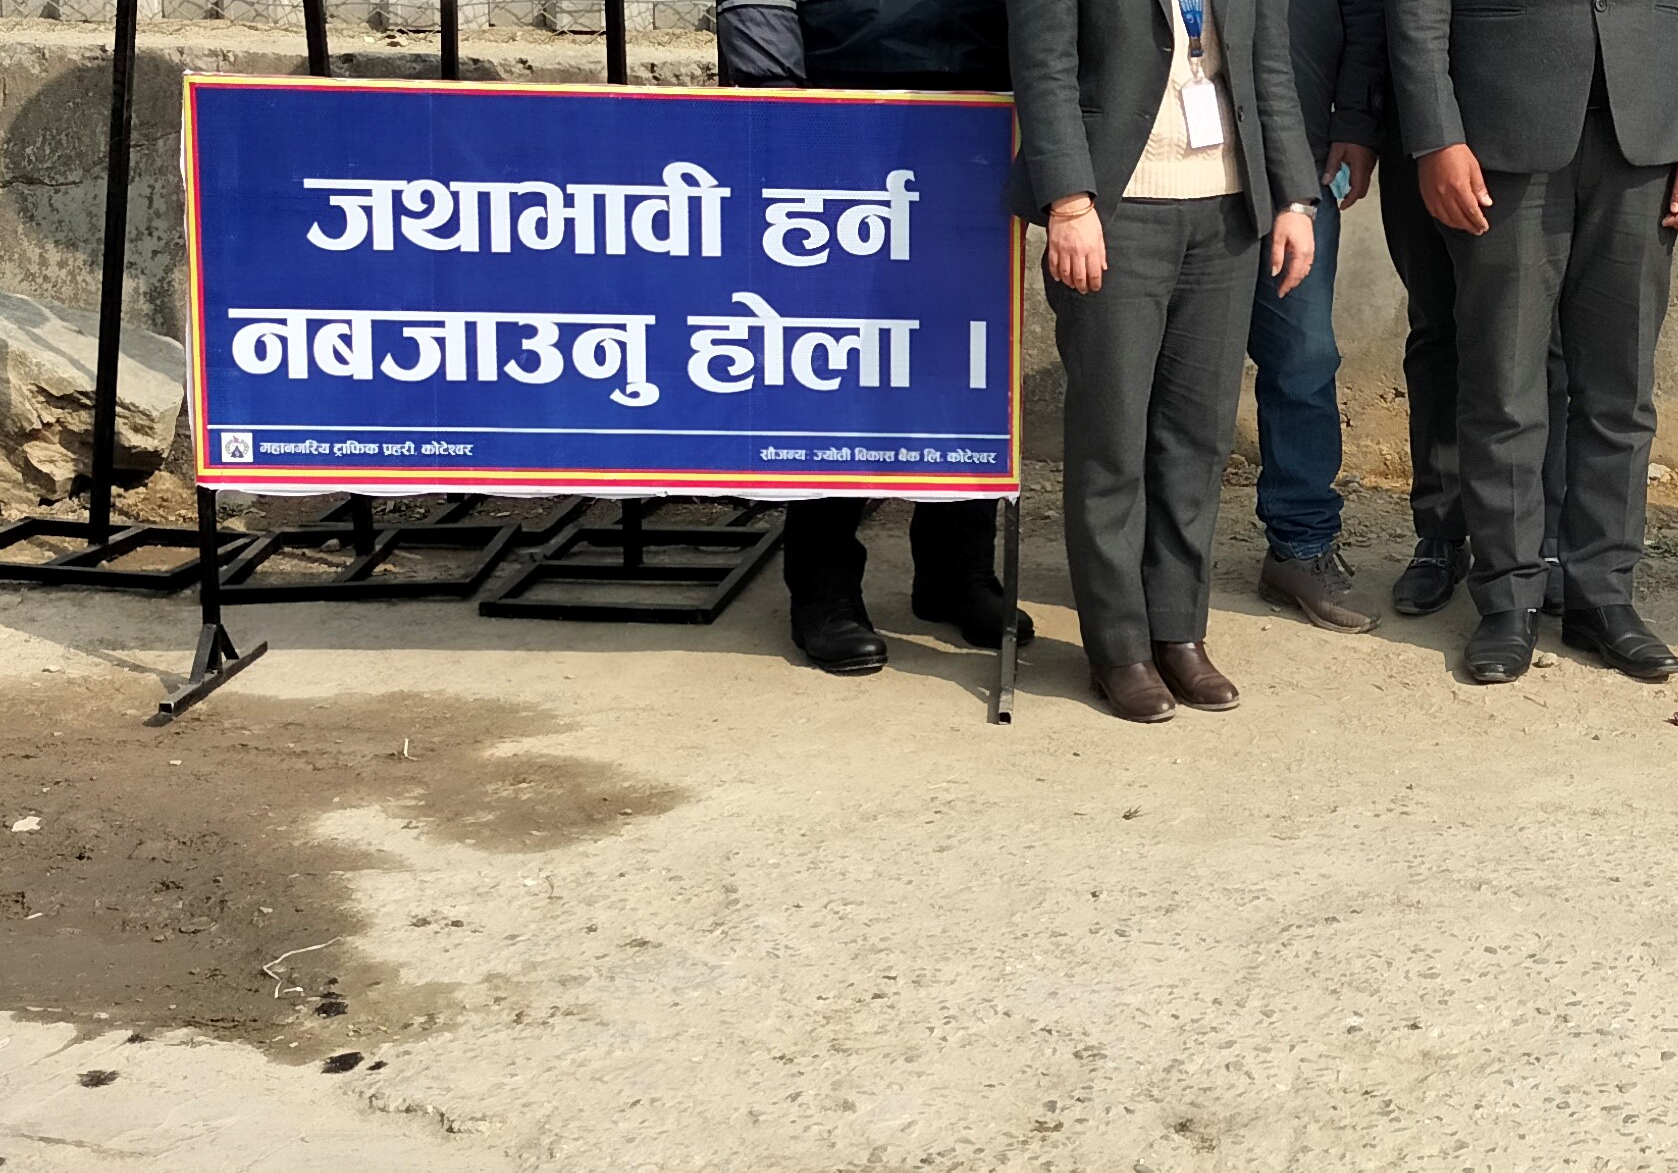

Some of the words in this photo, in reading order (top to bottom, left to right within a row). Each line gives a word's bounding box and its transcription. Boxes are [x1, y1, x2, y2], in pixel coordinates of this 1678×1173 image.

[303, 161, 731, 259] जथाभावी
[761, 169, 919, 267] हर्न
[227, 307, 656, 407] नबजाउनु
[686, 291, 919, 392] होला
